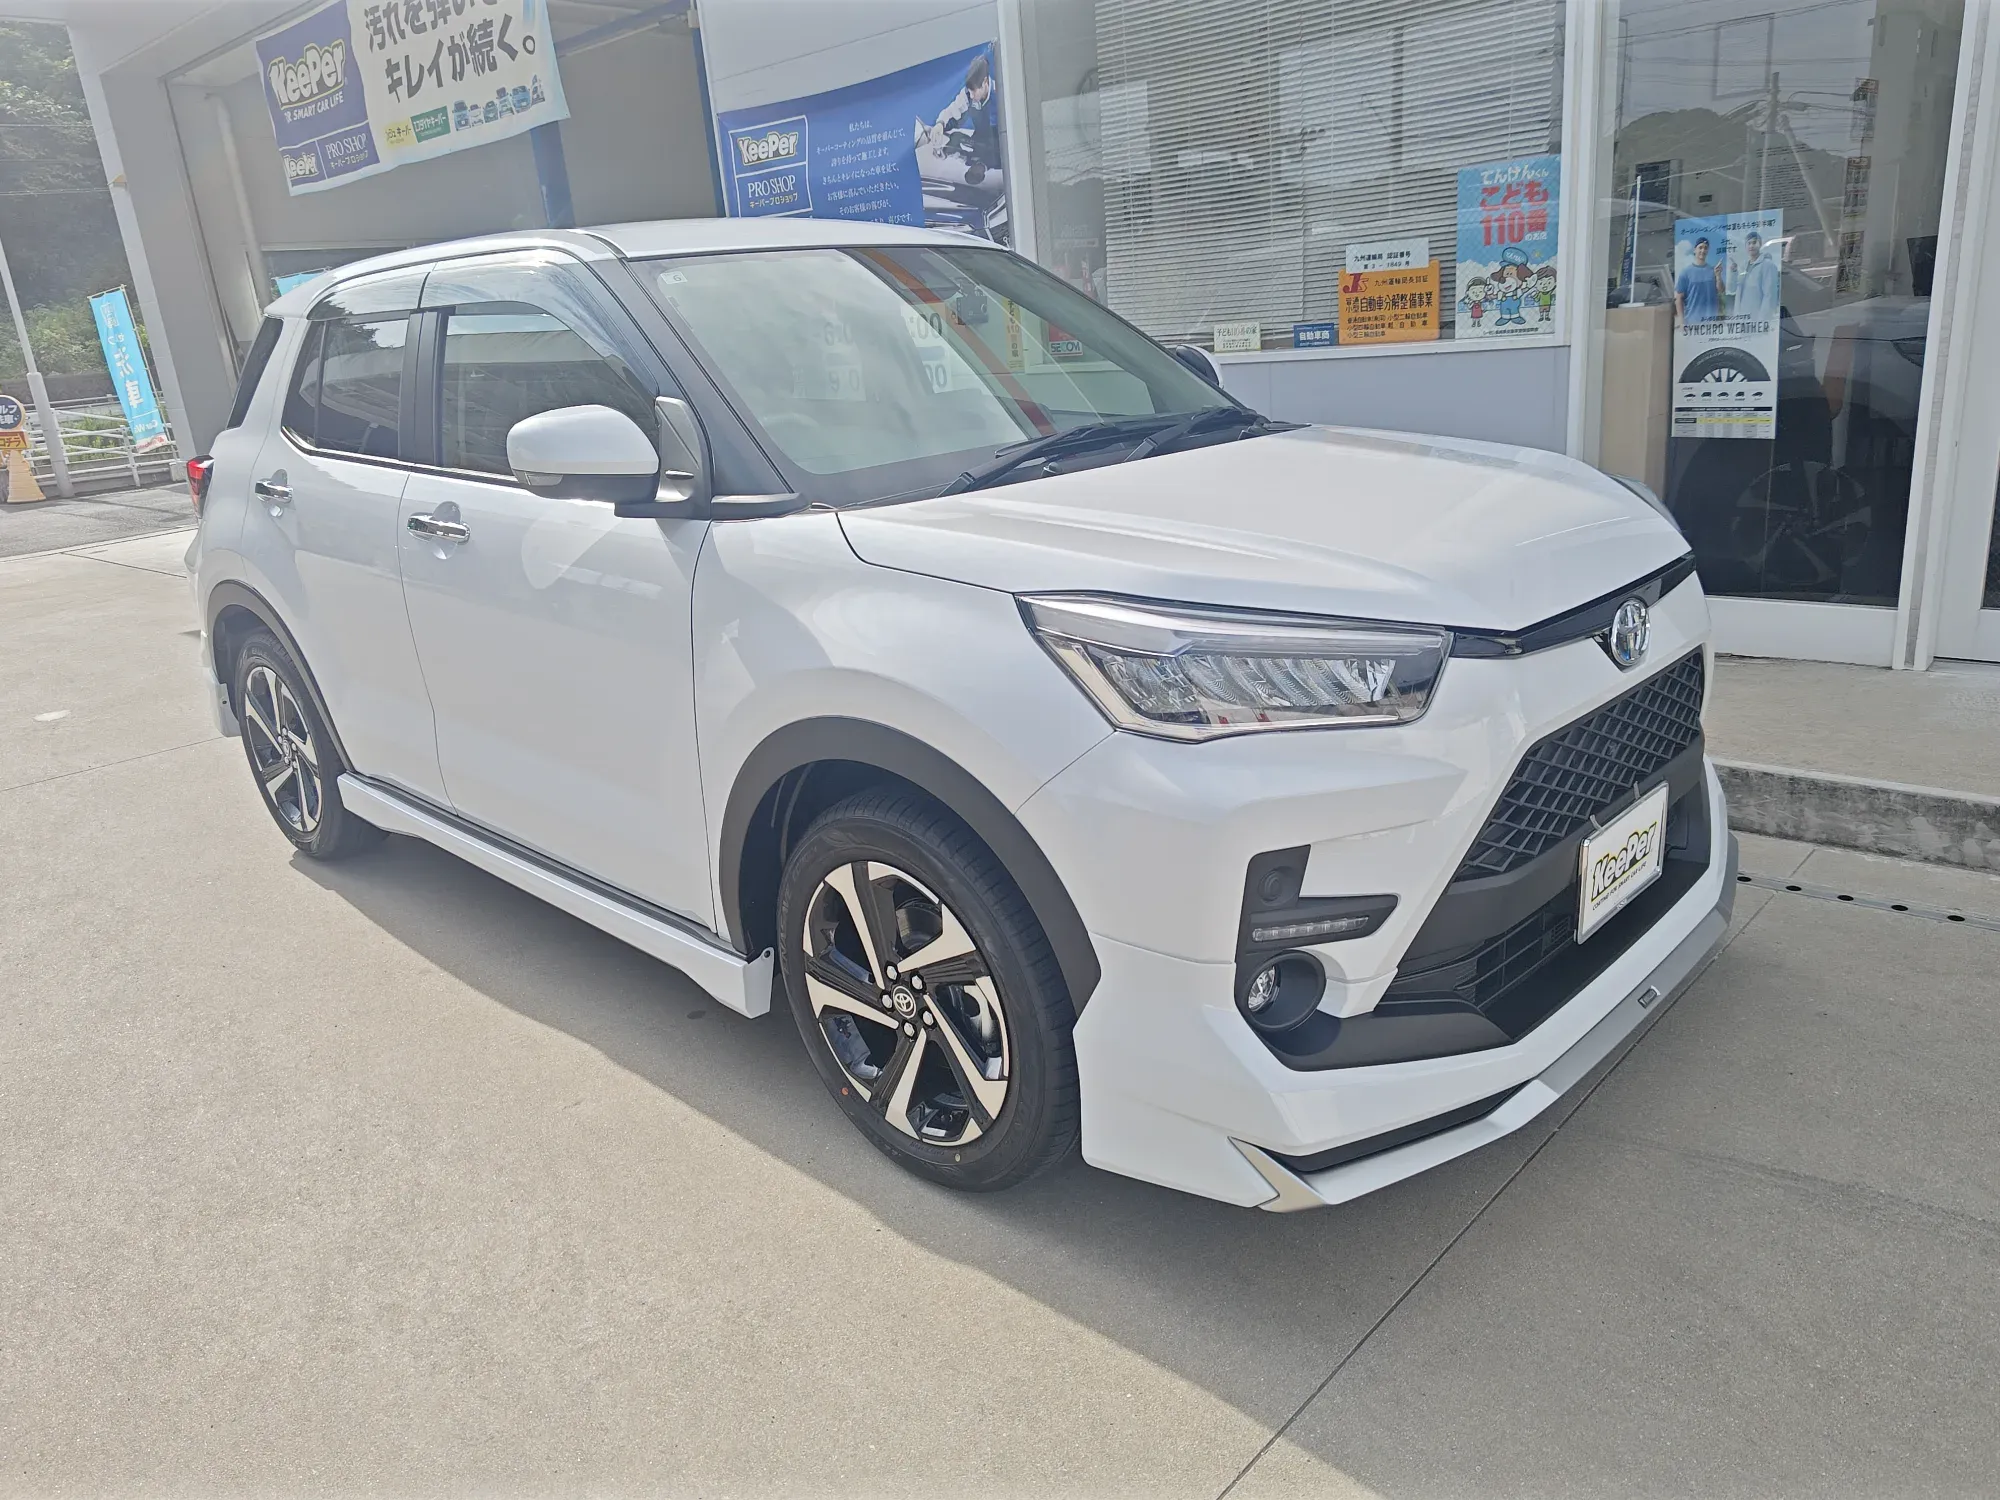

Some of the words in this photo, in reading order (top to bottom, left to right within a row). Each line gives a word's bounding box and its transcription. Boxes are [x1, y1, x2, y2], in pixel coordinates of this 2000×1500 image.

[364, 0, 498, 53] 汚れを弾い
[385, 13, 536, 103] キレイが続く。
[268, 39, 346, 109] KeePer
[293, 105, 317, 122] SMART
[317, 98, 329, 114] CAR
[329, 91, 345, 109] LIFE
[325, 139, 343, 159] PRO
[737, 131, 798, 165] KeePer
[1481, 164, 1549, 185] てんけんくん
[747, 178, 770, 198] PRO
[770, 175, 796, 195] SHOP
[1480, 180, 1549, 211] こども
[749, 193, 798, 209] キーパープロショップ
[1360, 291, 1434, 312] 自動車分解整備事業
[1683, 323, 1724, 337] SYNCHRO
[1727, 321, 1769, 335] WEATHER
[1051, 341, 1080, 353] SECOM
[0, 404, 18, 414] ルフ
[1591, 822, 1657, 902] KeePer
